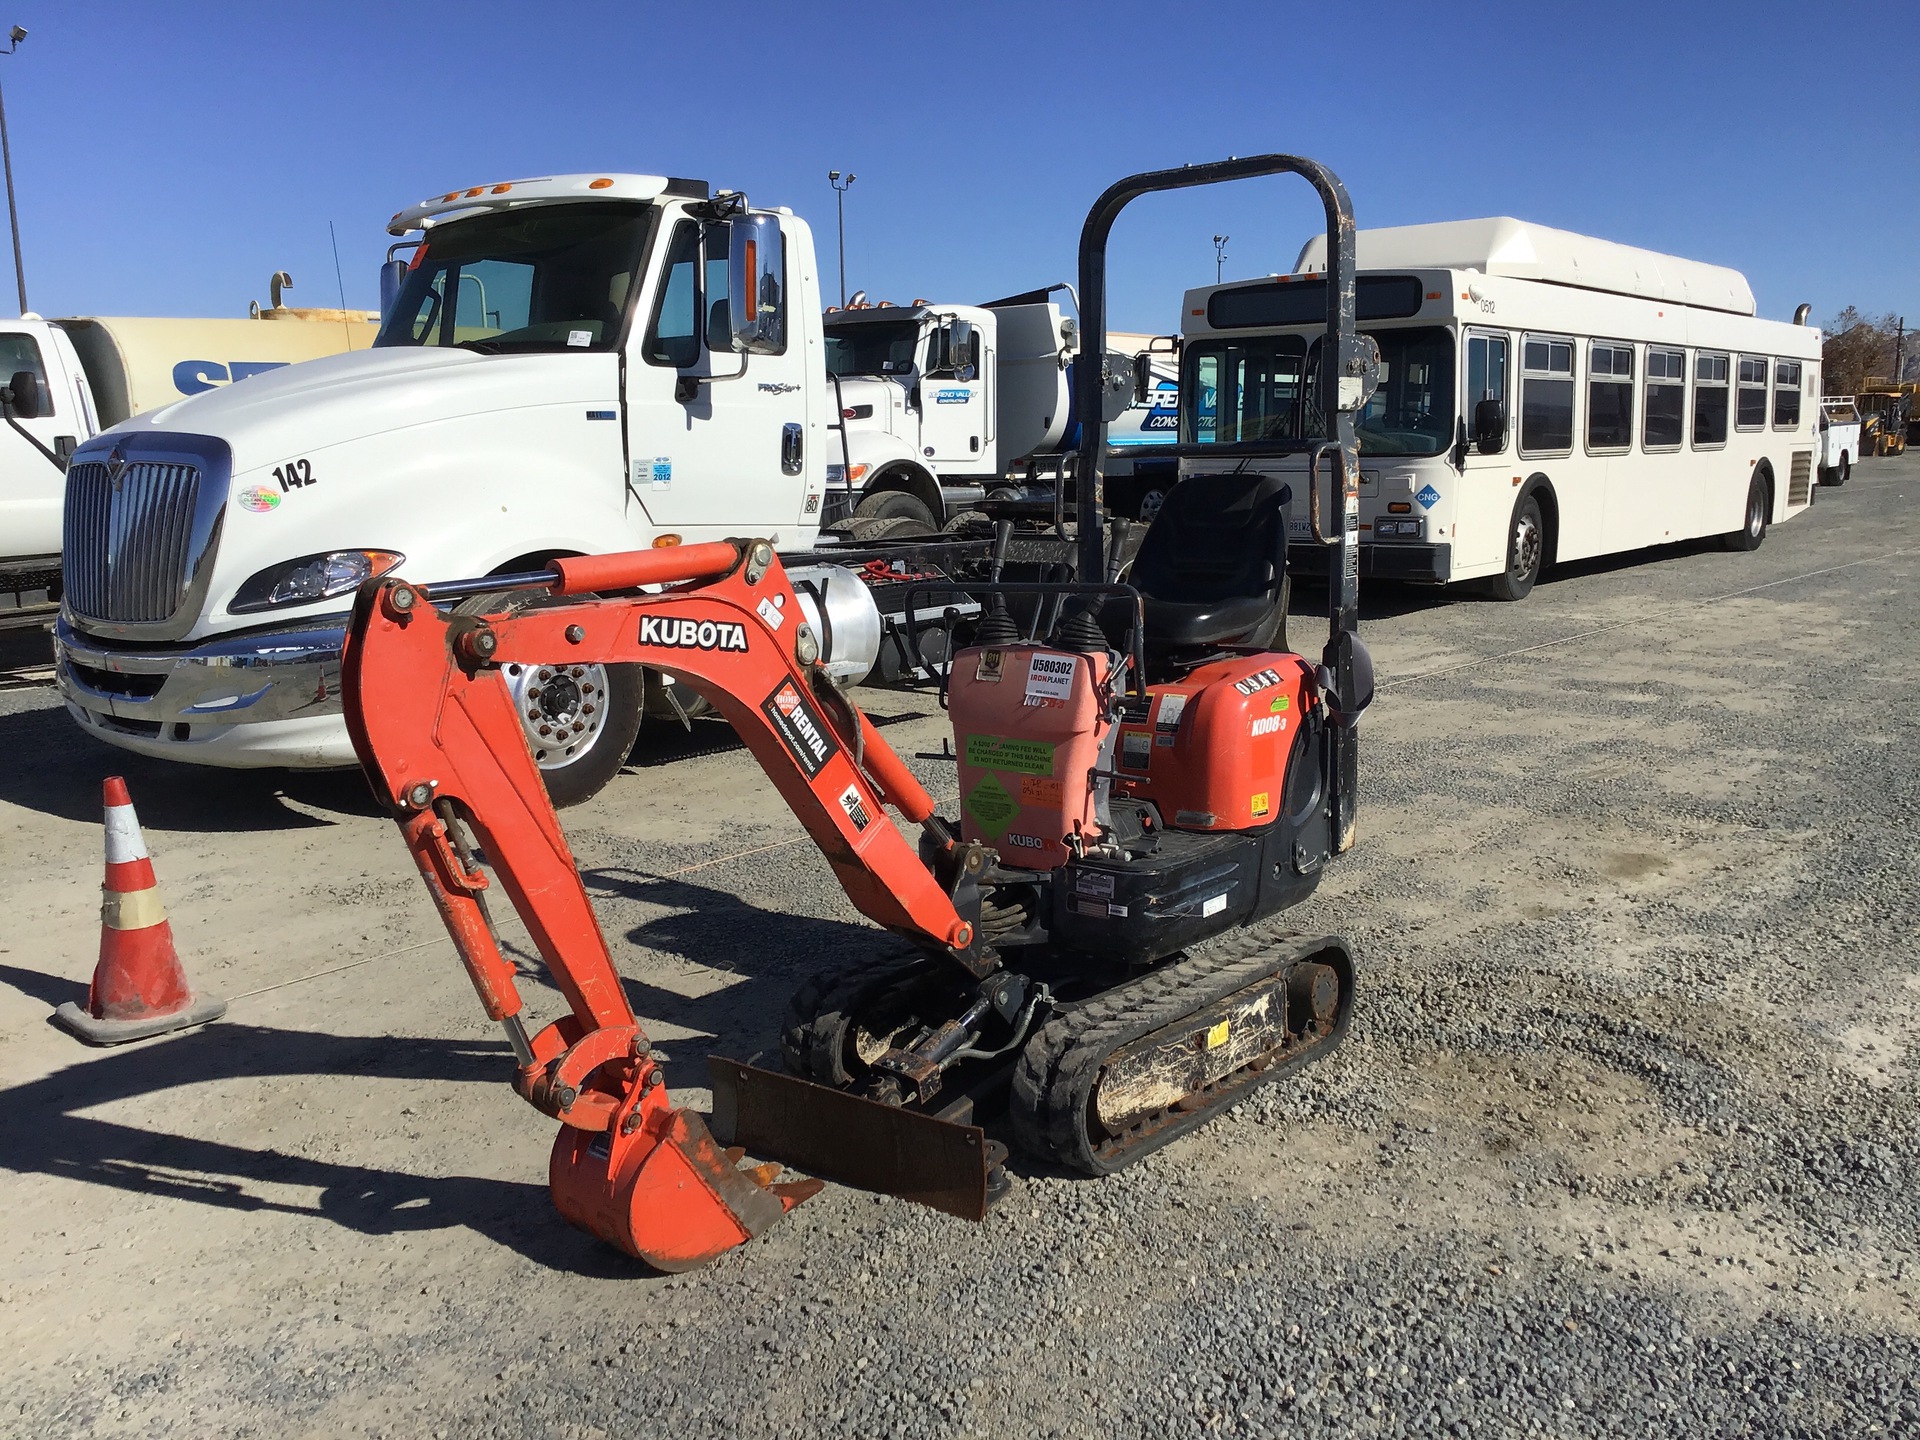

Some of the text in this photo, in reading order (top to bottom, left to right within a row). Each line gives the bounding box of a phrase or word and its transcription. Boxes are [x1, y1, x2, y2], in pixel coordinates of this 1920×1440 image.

[272, 458, 317, 493] 142
[653, 473, 671, 481] 2012
[1417, 493, 1438, 501] CNG
[806, 499, 818, 512] 80
[640, 616, 747, 650] KUBOTA
[1032, 658, 1073, 675] U580302
[1030, 673, 1070, 685] IRONPLANET
[777, 695, 798, 704] HOME
[1251, 714, 1287, 737] K008-3
[770, 706, 816, 773] homedepot.com/rental
[789, 705, 828, 763] RENTAL
[976, 748, 1004, 757] CHARGED
[1011, 752, 1024, 760] THIS
[1025, 754, 1052, 763] MACHINE
[1020, 745, 1032, 753] FEE
[1032, 747, 1047, 755] WILL
[992, 758, 1024, 767] RETURNED
[1024, 762, 1045, 770] CLEAN
